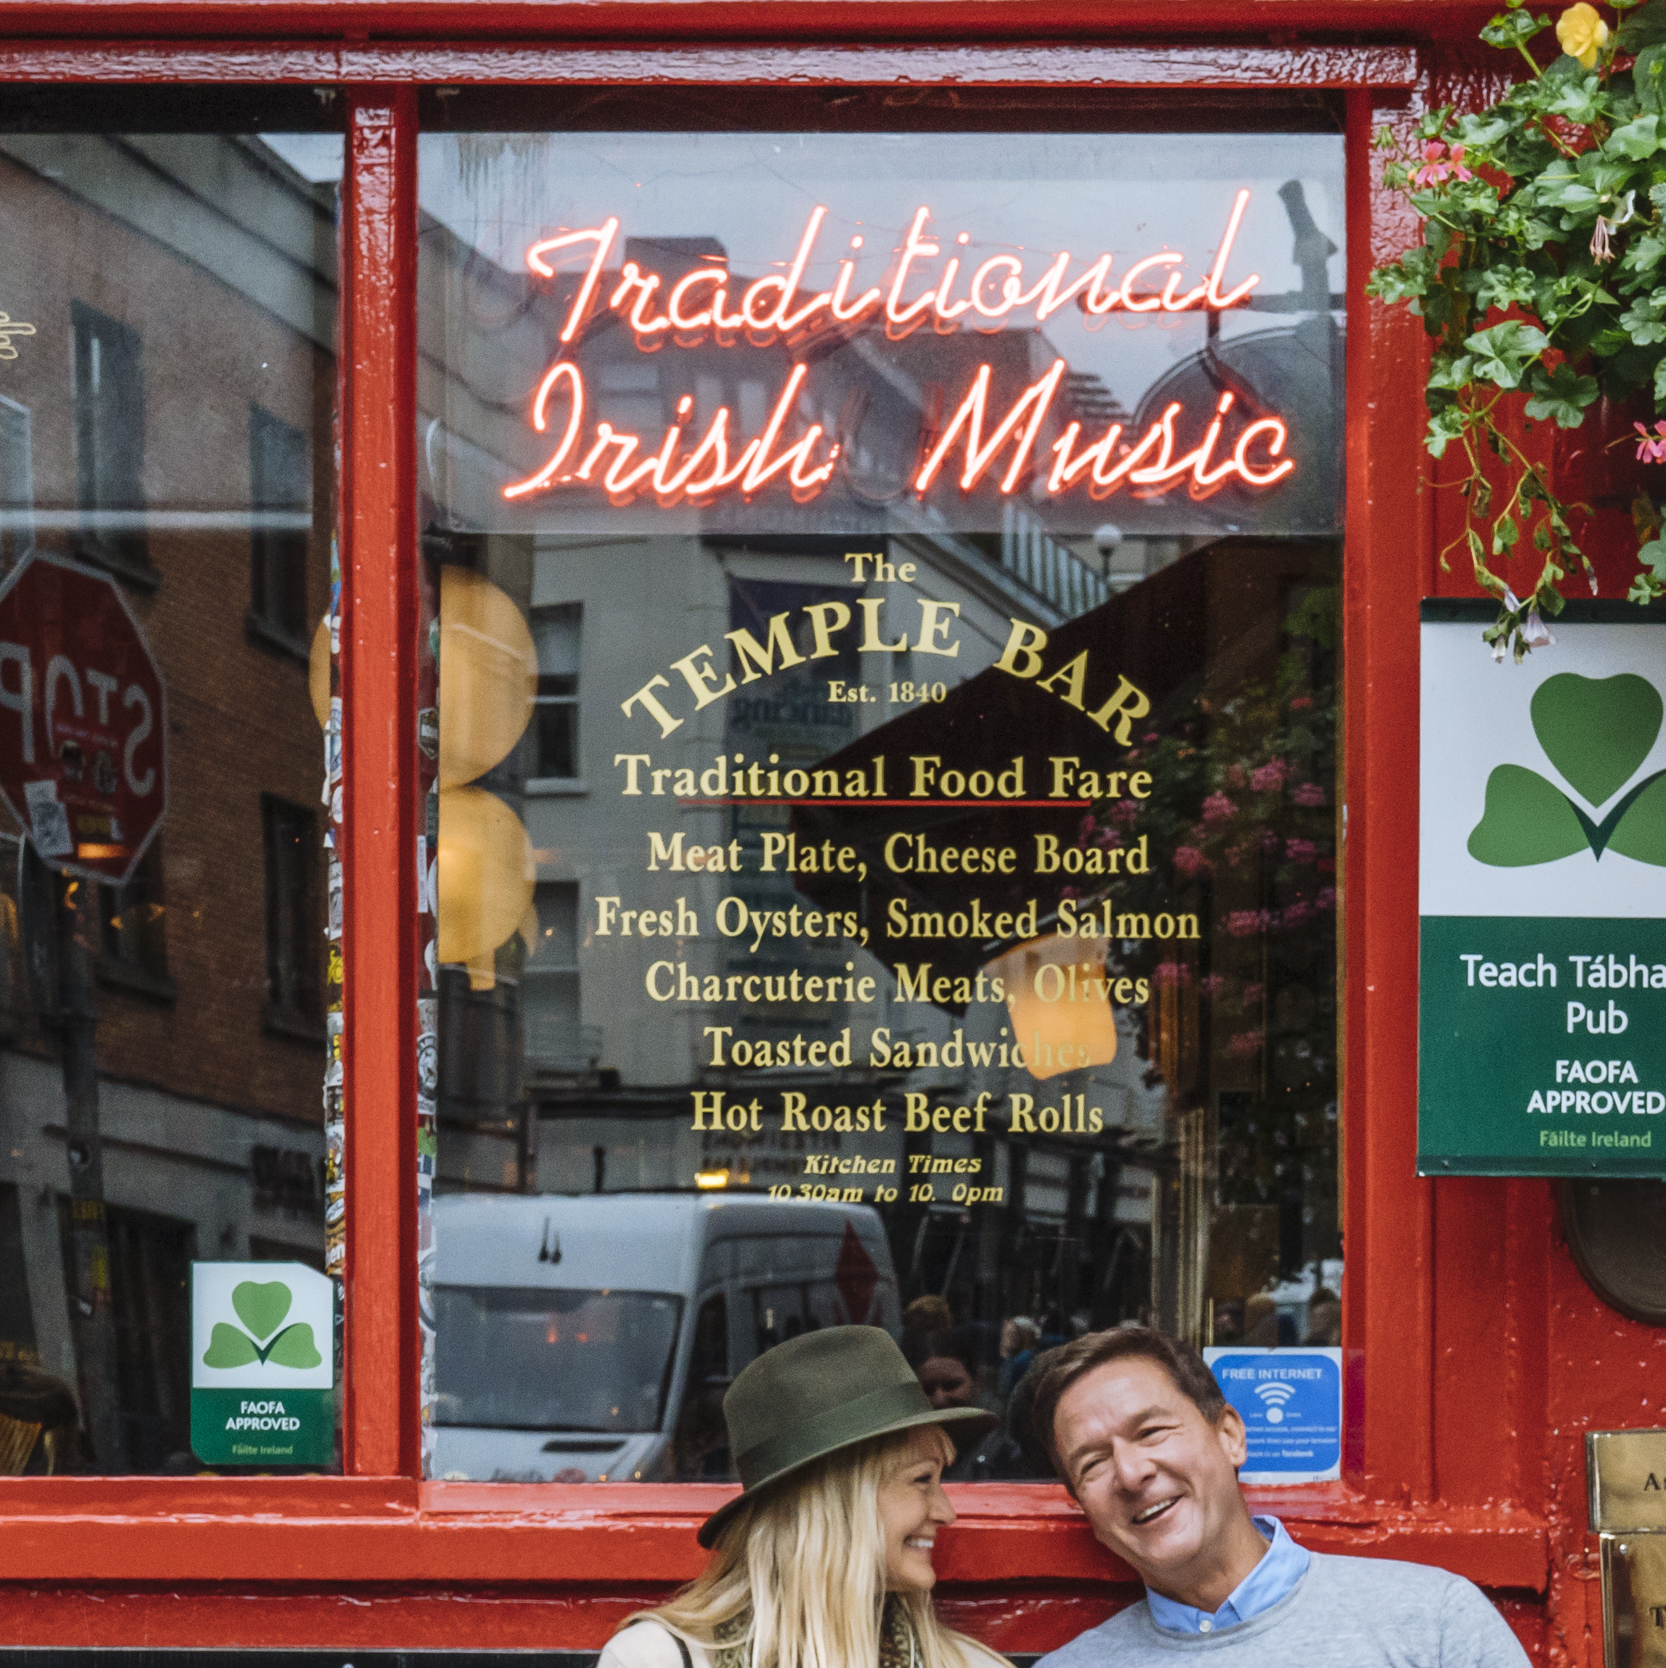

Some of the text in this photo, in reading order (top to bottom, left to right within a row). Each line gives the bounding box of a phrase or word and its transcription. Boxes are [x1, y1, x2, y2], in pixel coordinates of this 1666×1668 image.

[528, 189, 1259, 341] Traditional
[505, 360, 1294, 497] Irish Music
[844, 552, 917, 583] The
[619, 597, 1152, 747] TEMPLE BAR
[827, 681, 948, 703] Est. 1840
[614, 754, 1153, 800] Traditional Food Fare
[647, 832, 1150, 882] Meat Plate, Cheese Board
[595, 896, 1201, 953] Fresh Oysters, Smoked Salmon
[645, 960, 1150, 1005] Charcuterie Meats, Olives
[1459, 953, 1557, 987] Teach
[1567, 1000, 1629, 1034] Pub
[703, 1026, 1091, 1070] Toasted Sandwiches
[1555, 1060, 1639, 1083] FAOFA
[690, 1091, 1103, 1134] Hot Roast Beef Rolls
[1526, 1090, 1666, 1114] APPROVED
[1591, 1130, 1652, 1147] Ireland
[804, 1155, 983, 1174] Kitchen Times
[874, 1184, 898, 1201] to
[1222, 1368, 1323, 1380] FREE INTERNET
[225, 1417, 300, 1431] APPROVED
[240, 1401, 285, 1414] FAOFA
